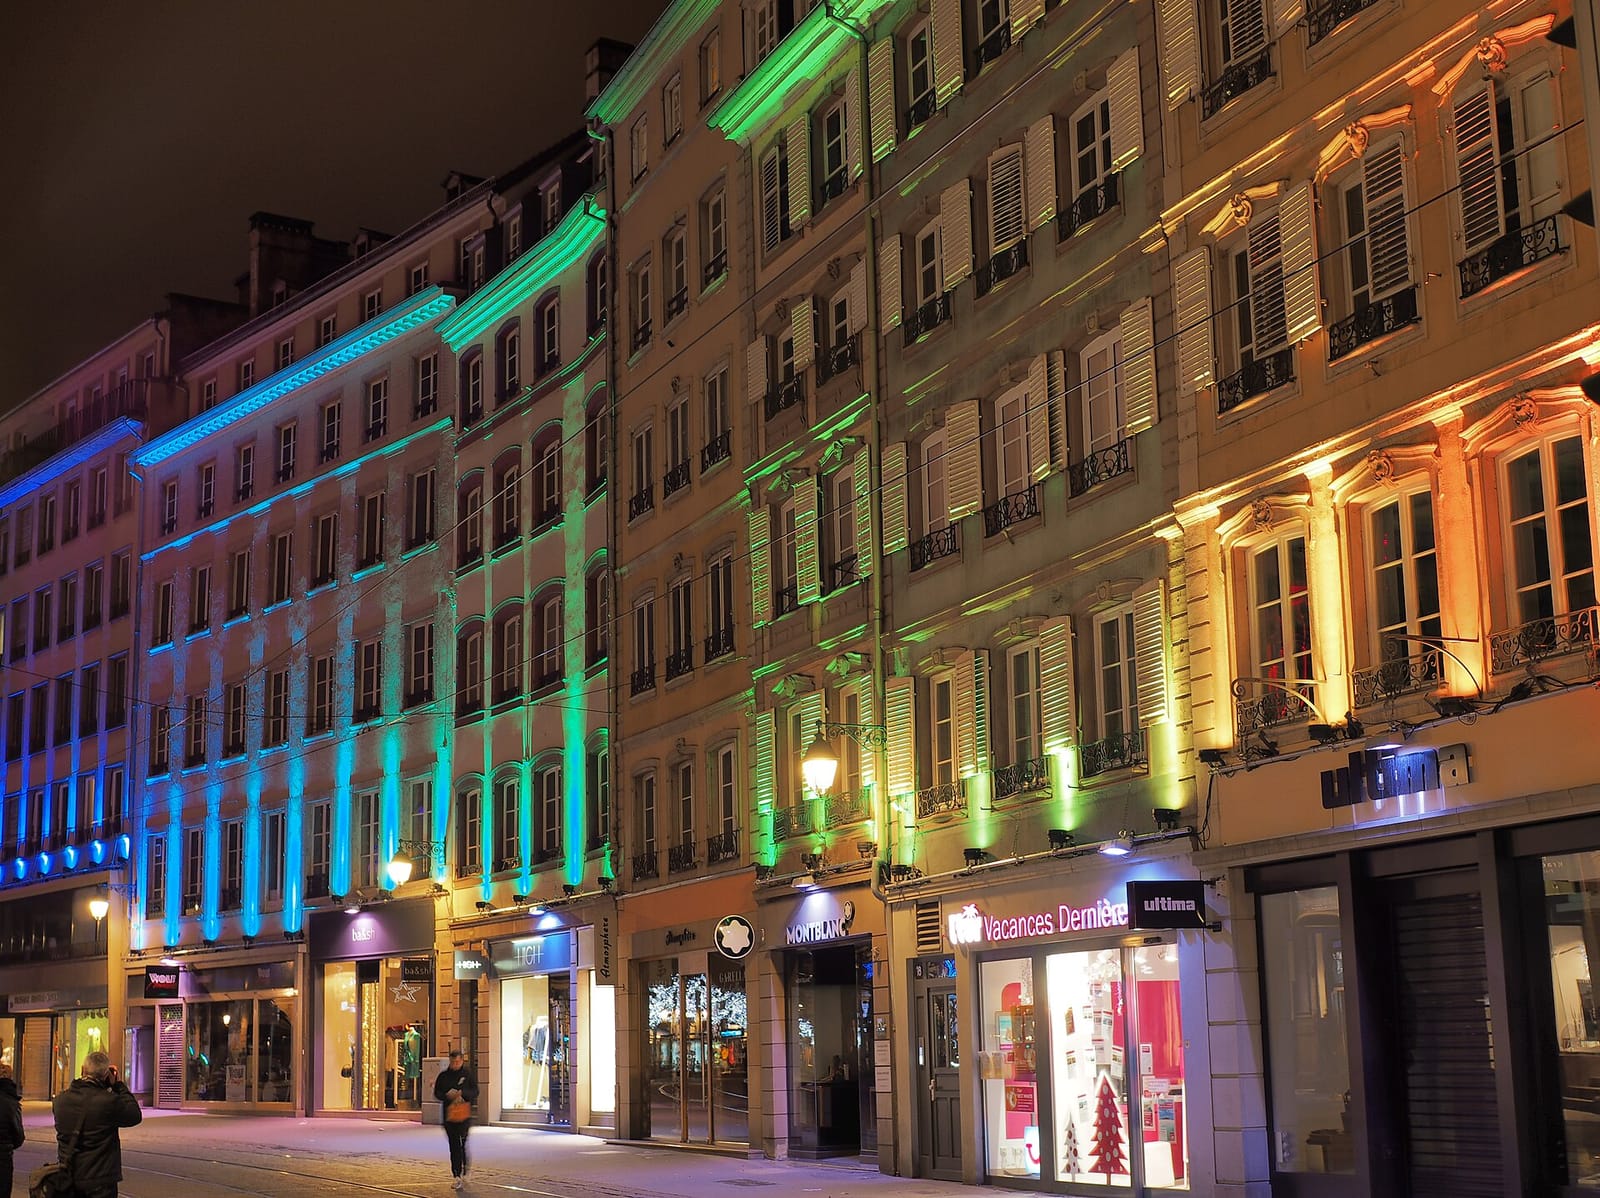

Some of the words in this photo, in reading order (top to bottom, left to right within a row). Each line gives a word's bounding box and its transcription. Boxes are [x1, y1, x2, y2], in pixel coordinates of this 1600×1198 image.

[1143, 896, 1196, 911] ultima
[351, 926, 377, 942] ba&sh
[786, 917, 846, 945] MONTBLANC
[983, 912, 1053, 941] Vacances
[600, 917, 611, 978] Atmosphere
[404, 966, 429, 975] ba&sh
